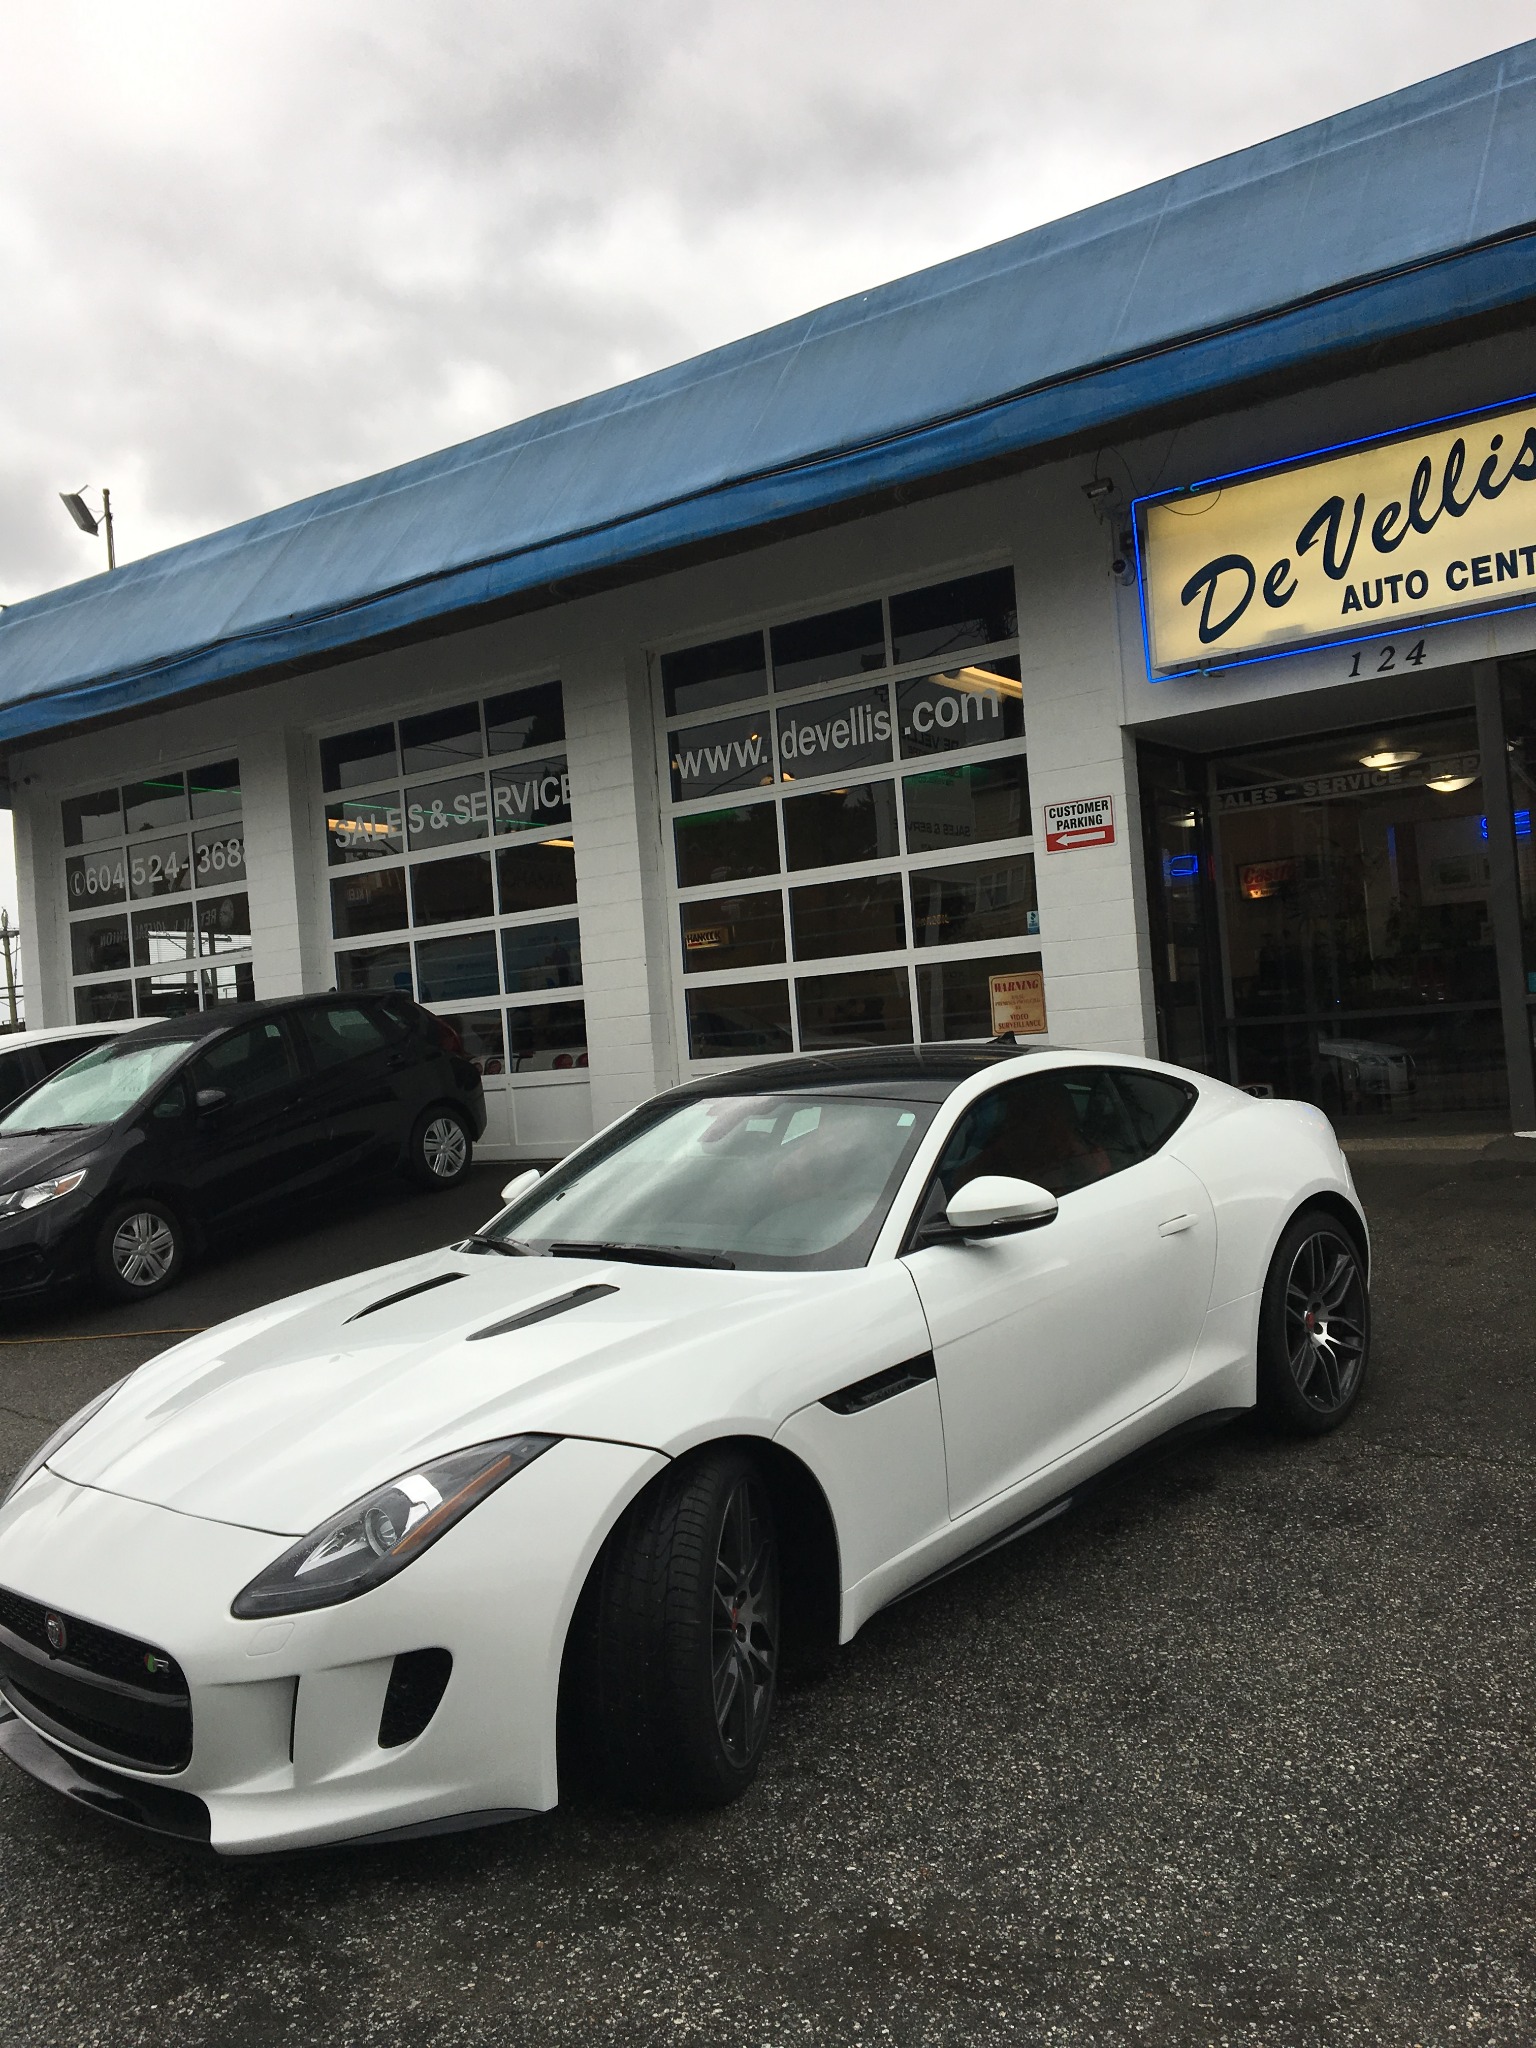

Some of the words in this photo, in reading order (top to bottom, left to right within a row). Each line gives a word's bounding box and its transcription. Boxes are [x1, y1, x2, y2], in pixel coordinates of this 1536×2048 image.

[1341, 568, 1429, 615] AUTO
[1348, 639, 1427, 678] 124
[1303, 768, 1401, 797] SERVICE
[1049, 800, 1109, 819] CUSTOMER
[335, 803, 425, 847] SALES
[429, 799, 449, 830] &
[1056, 814, 1103, 831] PARKING
[86, 862, 126, 895] 604
[994, 979, 1039, 993] WARNING
[998, 1019, 1042, 1030] SURVEILLANCE
[1010, 1013, 1029, 1021] VIDEO
